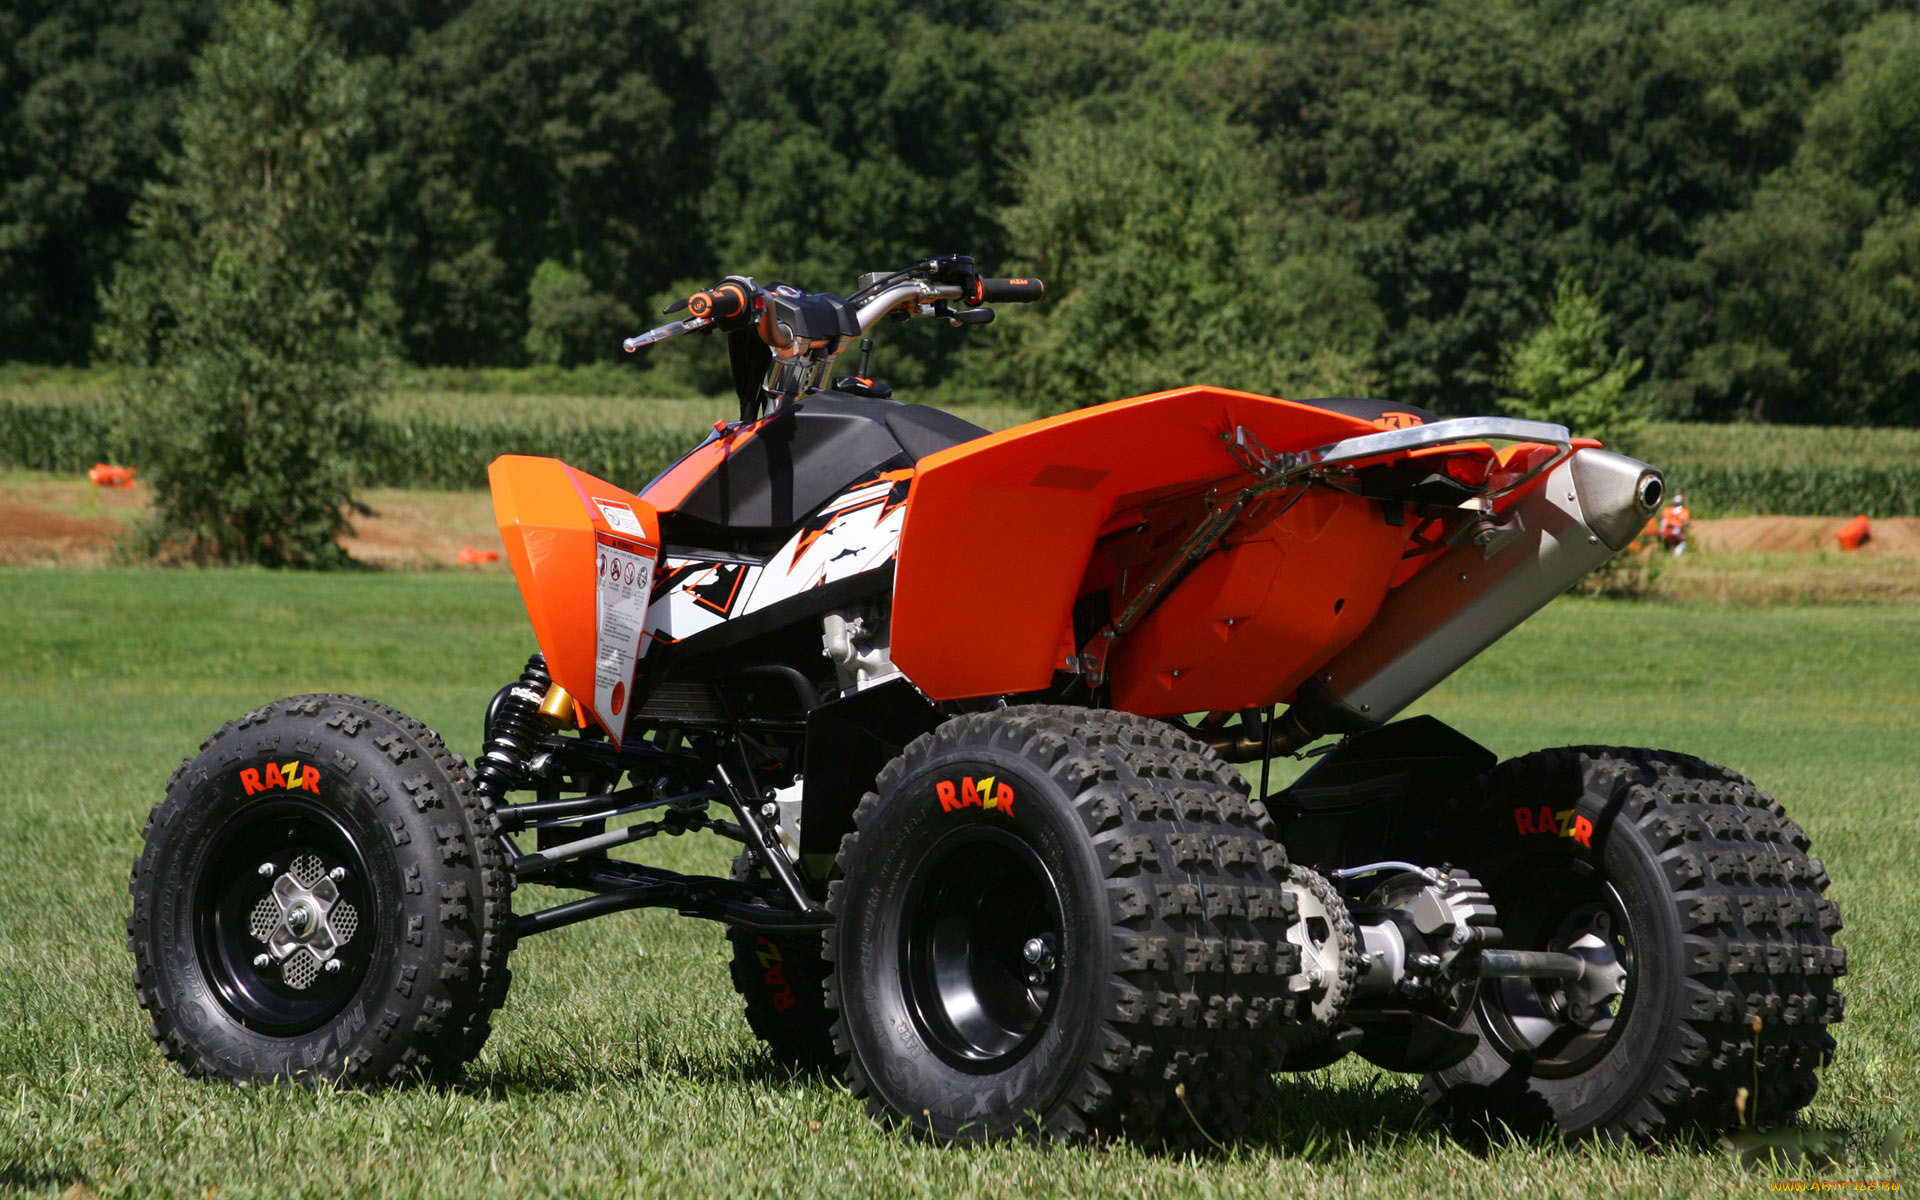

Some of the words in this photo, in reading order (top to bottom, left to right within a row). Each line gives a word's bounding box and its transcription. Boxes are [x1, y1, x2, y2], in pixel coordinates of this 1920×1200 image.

[240, 760, 321, 796] RAZR
[935, 775, 1015, 817] RAZR
[1513, 804, 1594, 849] RAZR
